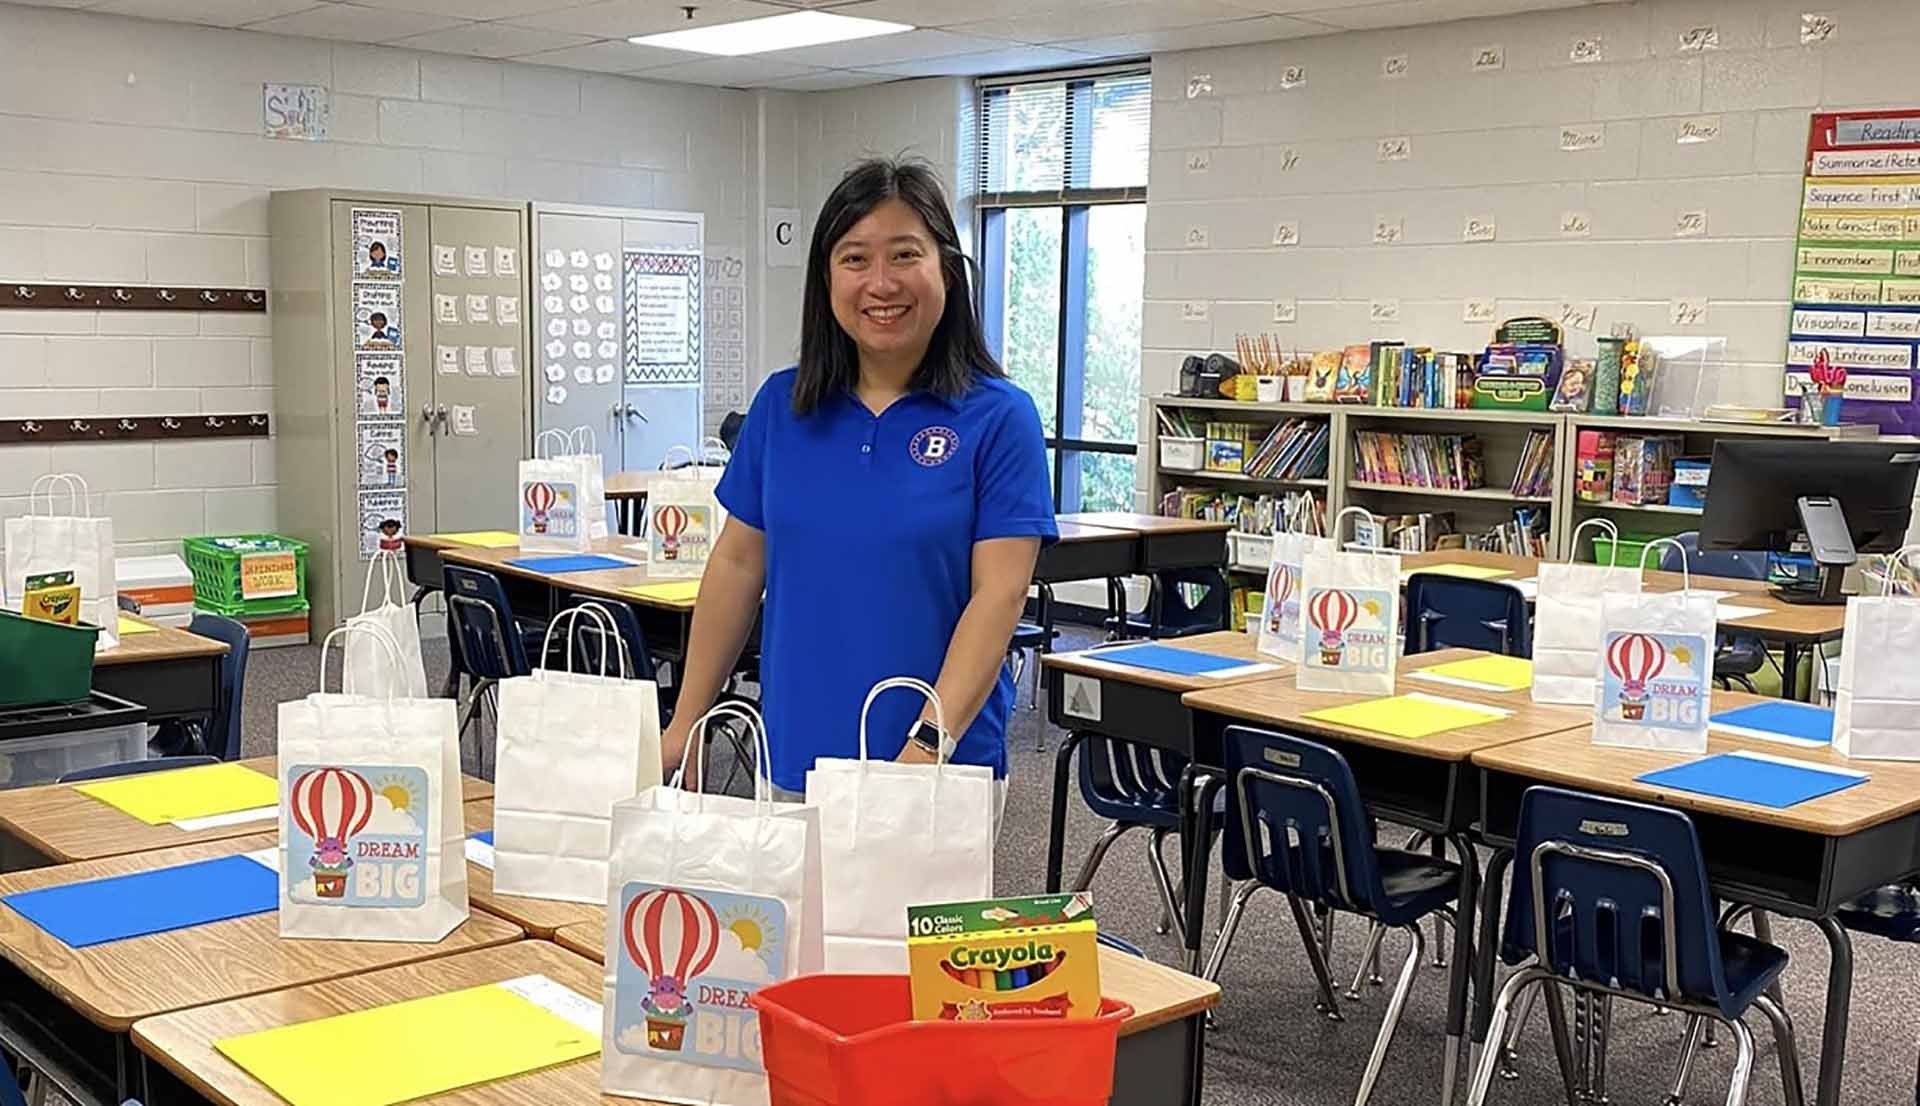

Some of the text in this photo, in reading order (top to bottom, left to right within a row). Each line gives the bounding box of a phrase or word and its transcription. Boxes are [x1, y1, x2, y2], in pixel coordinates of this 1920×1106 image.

[773, 219, 788, 239] C
[1827, 287, 1877, 302] uestions
[1795, 314, 1859, 332] Visualize
[1846, 379, 1908, 394] onclusion
[924, 435, 947, 458] B
[1653, 682, 1698, 697] DREAM
[1651, 697, 1698, 724] BIG
[356, 841, 420, 859] DREAM
[355, 861, 419, 898] BIG
[911, 914, 963, 936] 10 Classic
[934, 924, 963, 935] Colors
[950, 941, 1054, 968] Crayola
[697, 984, 764, 1010] DREA
